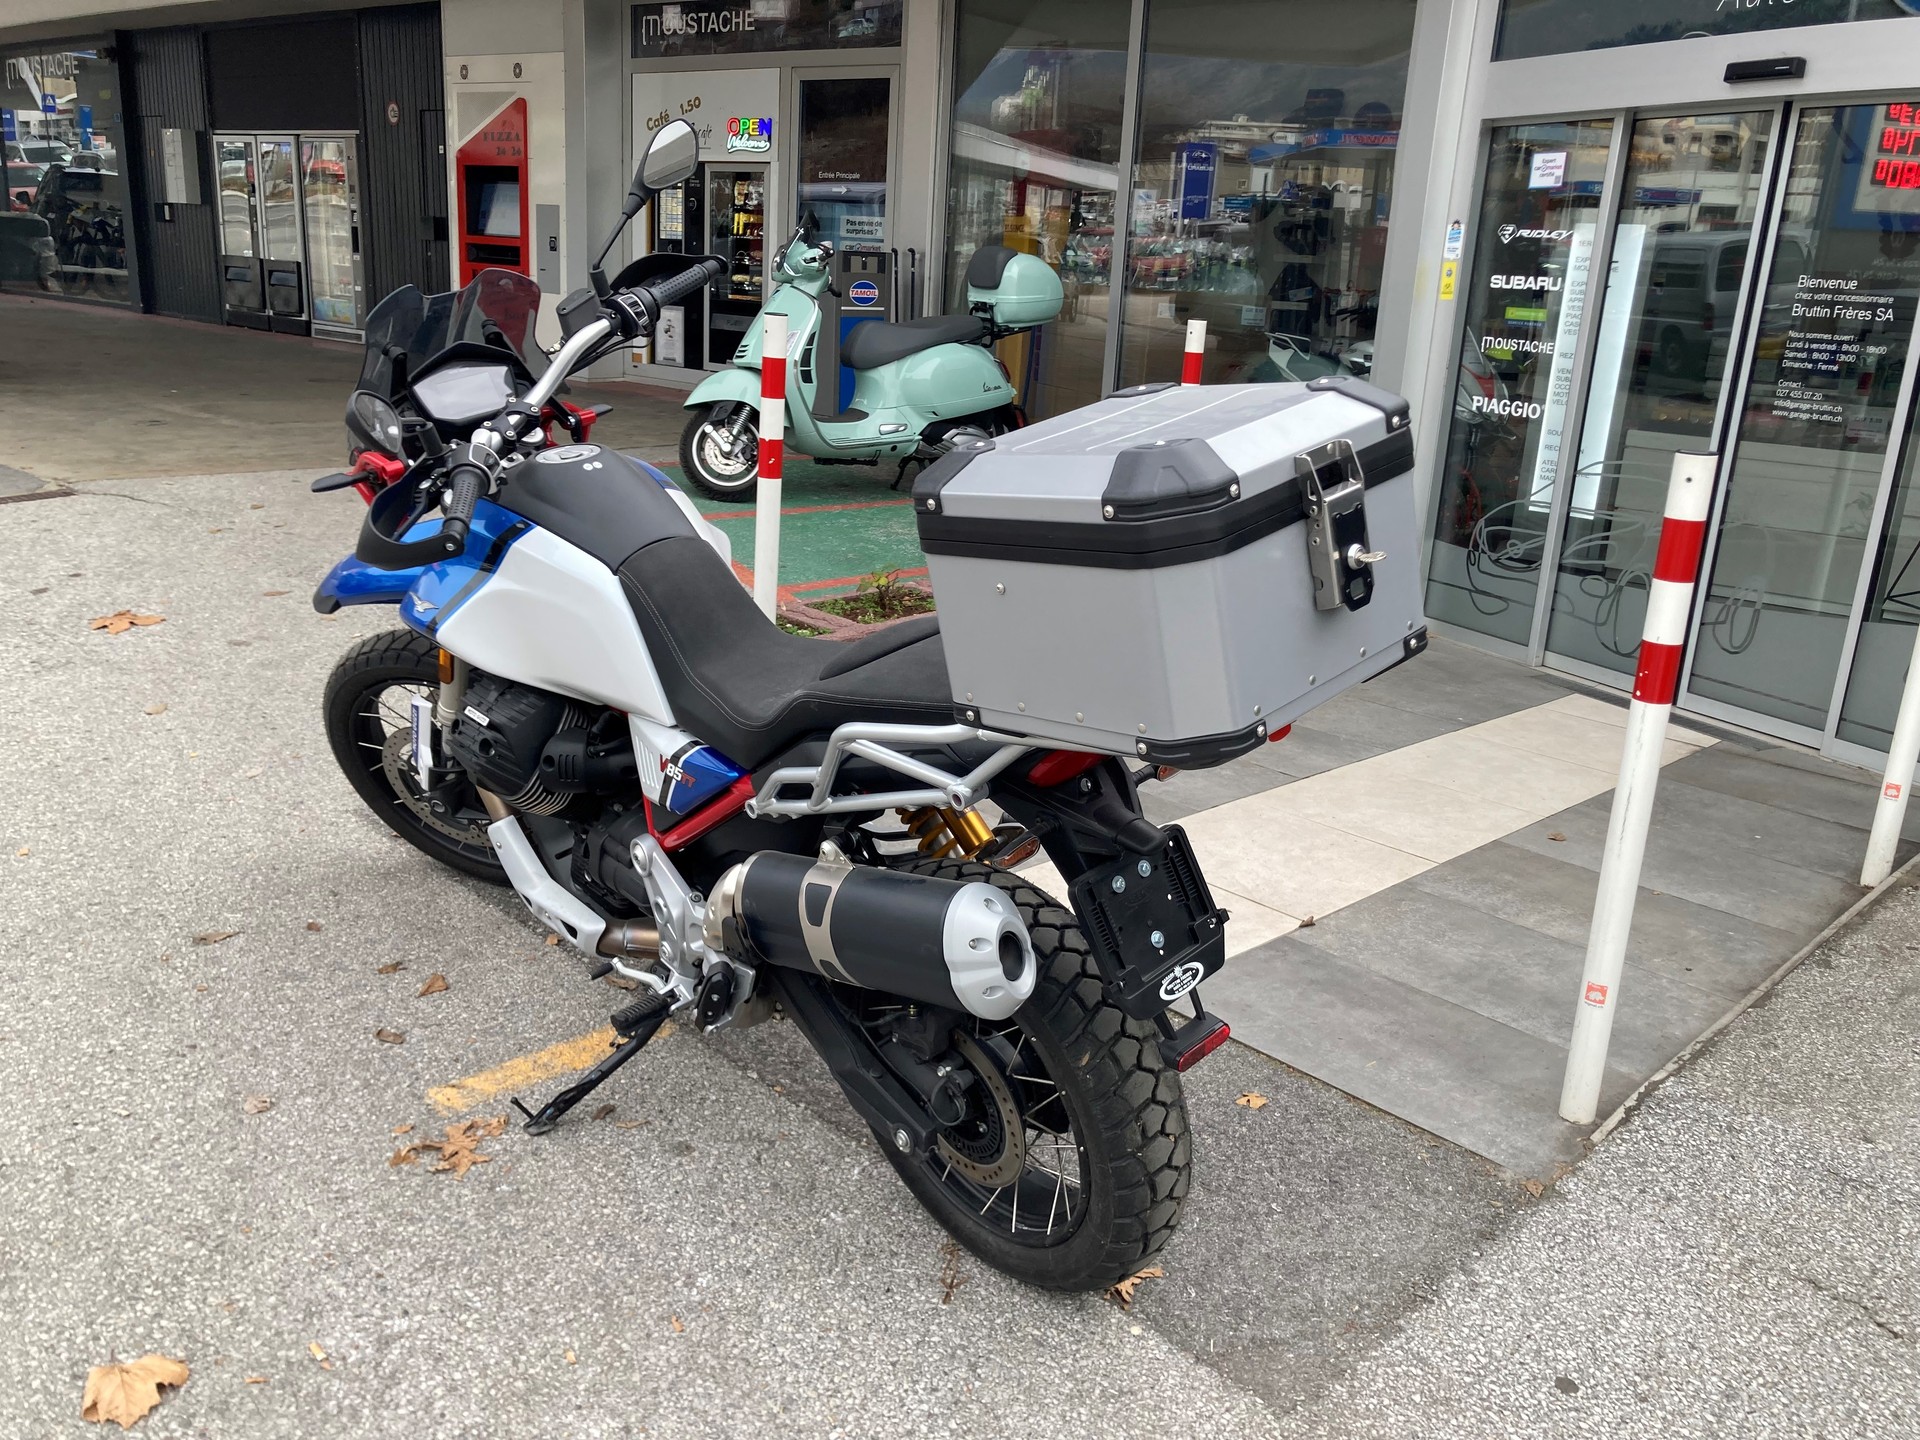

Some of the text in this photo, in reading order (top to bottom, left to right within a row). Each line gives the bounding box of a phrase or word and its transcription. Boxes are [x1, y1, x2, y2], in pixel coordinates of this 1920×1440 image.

[642, 10, 755, 45] MOUSTACHE
[646, 96, 701, 131] Café 1.50
[726, 117, 772, 136] OPEN
[726, 133, 770, 153] Welcome
[819, 171, 860, 180] Entrée Principale
[858, 219, 874, 227] envie
[846, 227, 873, 235] surprises
[1516, 229, 1574, 240] RIDLEY
[1490, 275, 1562, 291] SUBARU
[1797, 275, 1858, 290] Bienvenue
[1795, 292, 1894, 304] chez votre concessionnaire
[1792, 303, 1894, 321] Bruttin Frères SA
[1788, 330, 1804, 338] Nous
[1805, 332, 1832, 340] sommes
[1833, 334, 1854, 342] ouvert
[1481, 336, 1555, 354] MOUSTACHE
[1786, 340, 1803, 348] Lundi
[1804, 341, 1809, 349] à
[1810, 343, 1837, 351] vendredi
[1841, 344, 1860, 352] 8h00
[1866, 345, 1887, 355] 18h00
[1784, 350, 1807, 359] Samedi
[1812, 352, 1830, 360] 8h00
[1836, 353, 1856, 363] 13h00
[1782, 359, 1813, 369] Dimanche
[1817, 362, 1839, 371] Fermé
[1778, 379, 1801, 388] Contact
[1789, 390, 1802, 398] 455
[1803, 391, 1812, 399] 07
[1812, 392, 1823, 400] 20
[1472, 396, 1541, 419] PIAGGIO
[1773, 399, 1843, 413] info@garage-bruttin.ch
[1772, 409, 1843, 422] www.garage-bruttin.ch
